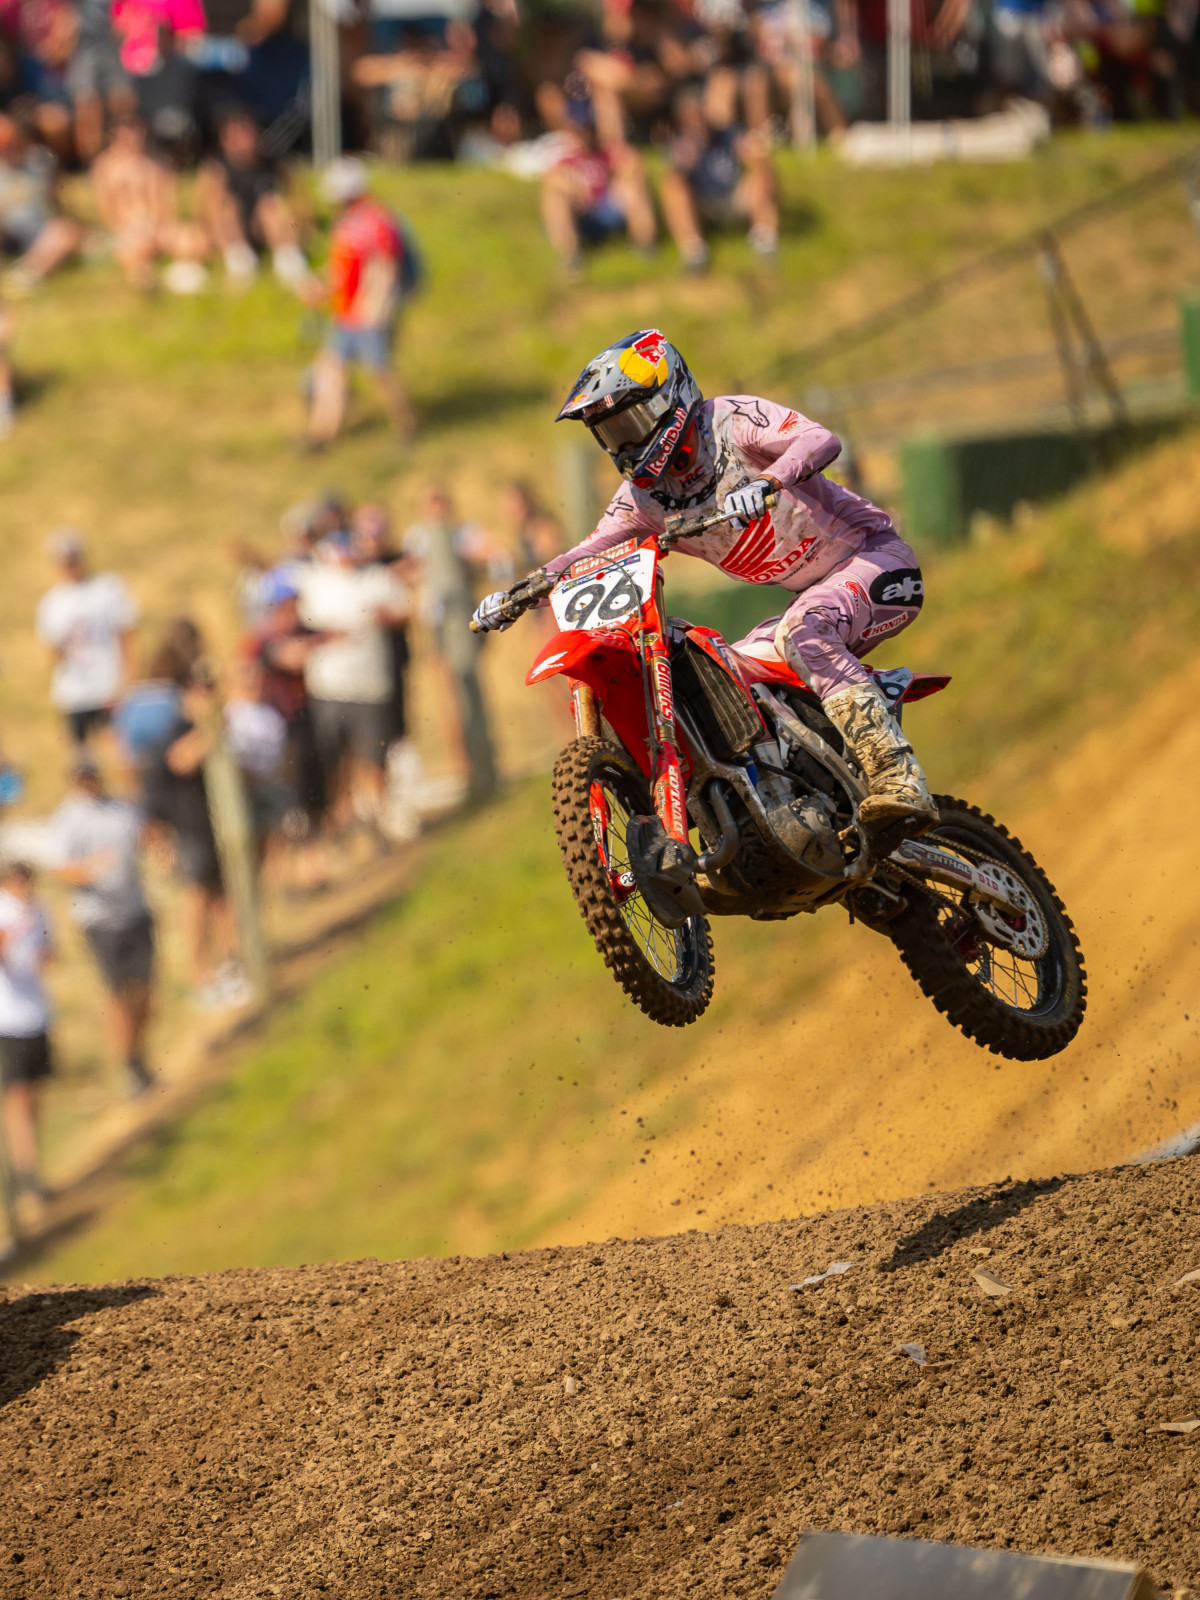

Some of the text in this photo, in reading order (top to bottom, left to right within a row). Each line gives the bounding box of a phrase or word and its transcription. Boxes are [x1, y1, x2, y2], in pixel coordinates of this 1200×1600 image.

[645, 407, 688, 477] Red Bull
[575, 546, 632, 574] RENTHAL
[565, 570, 644, 630] 96
[871, 613, 907, 636] HONDA
[657, 662, 673, 720] SHOWA
[668, 765, 684, 835] DUNLOP
